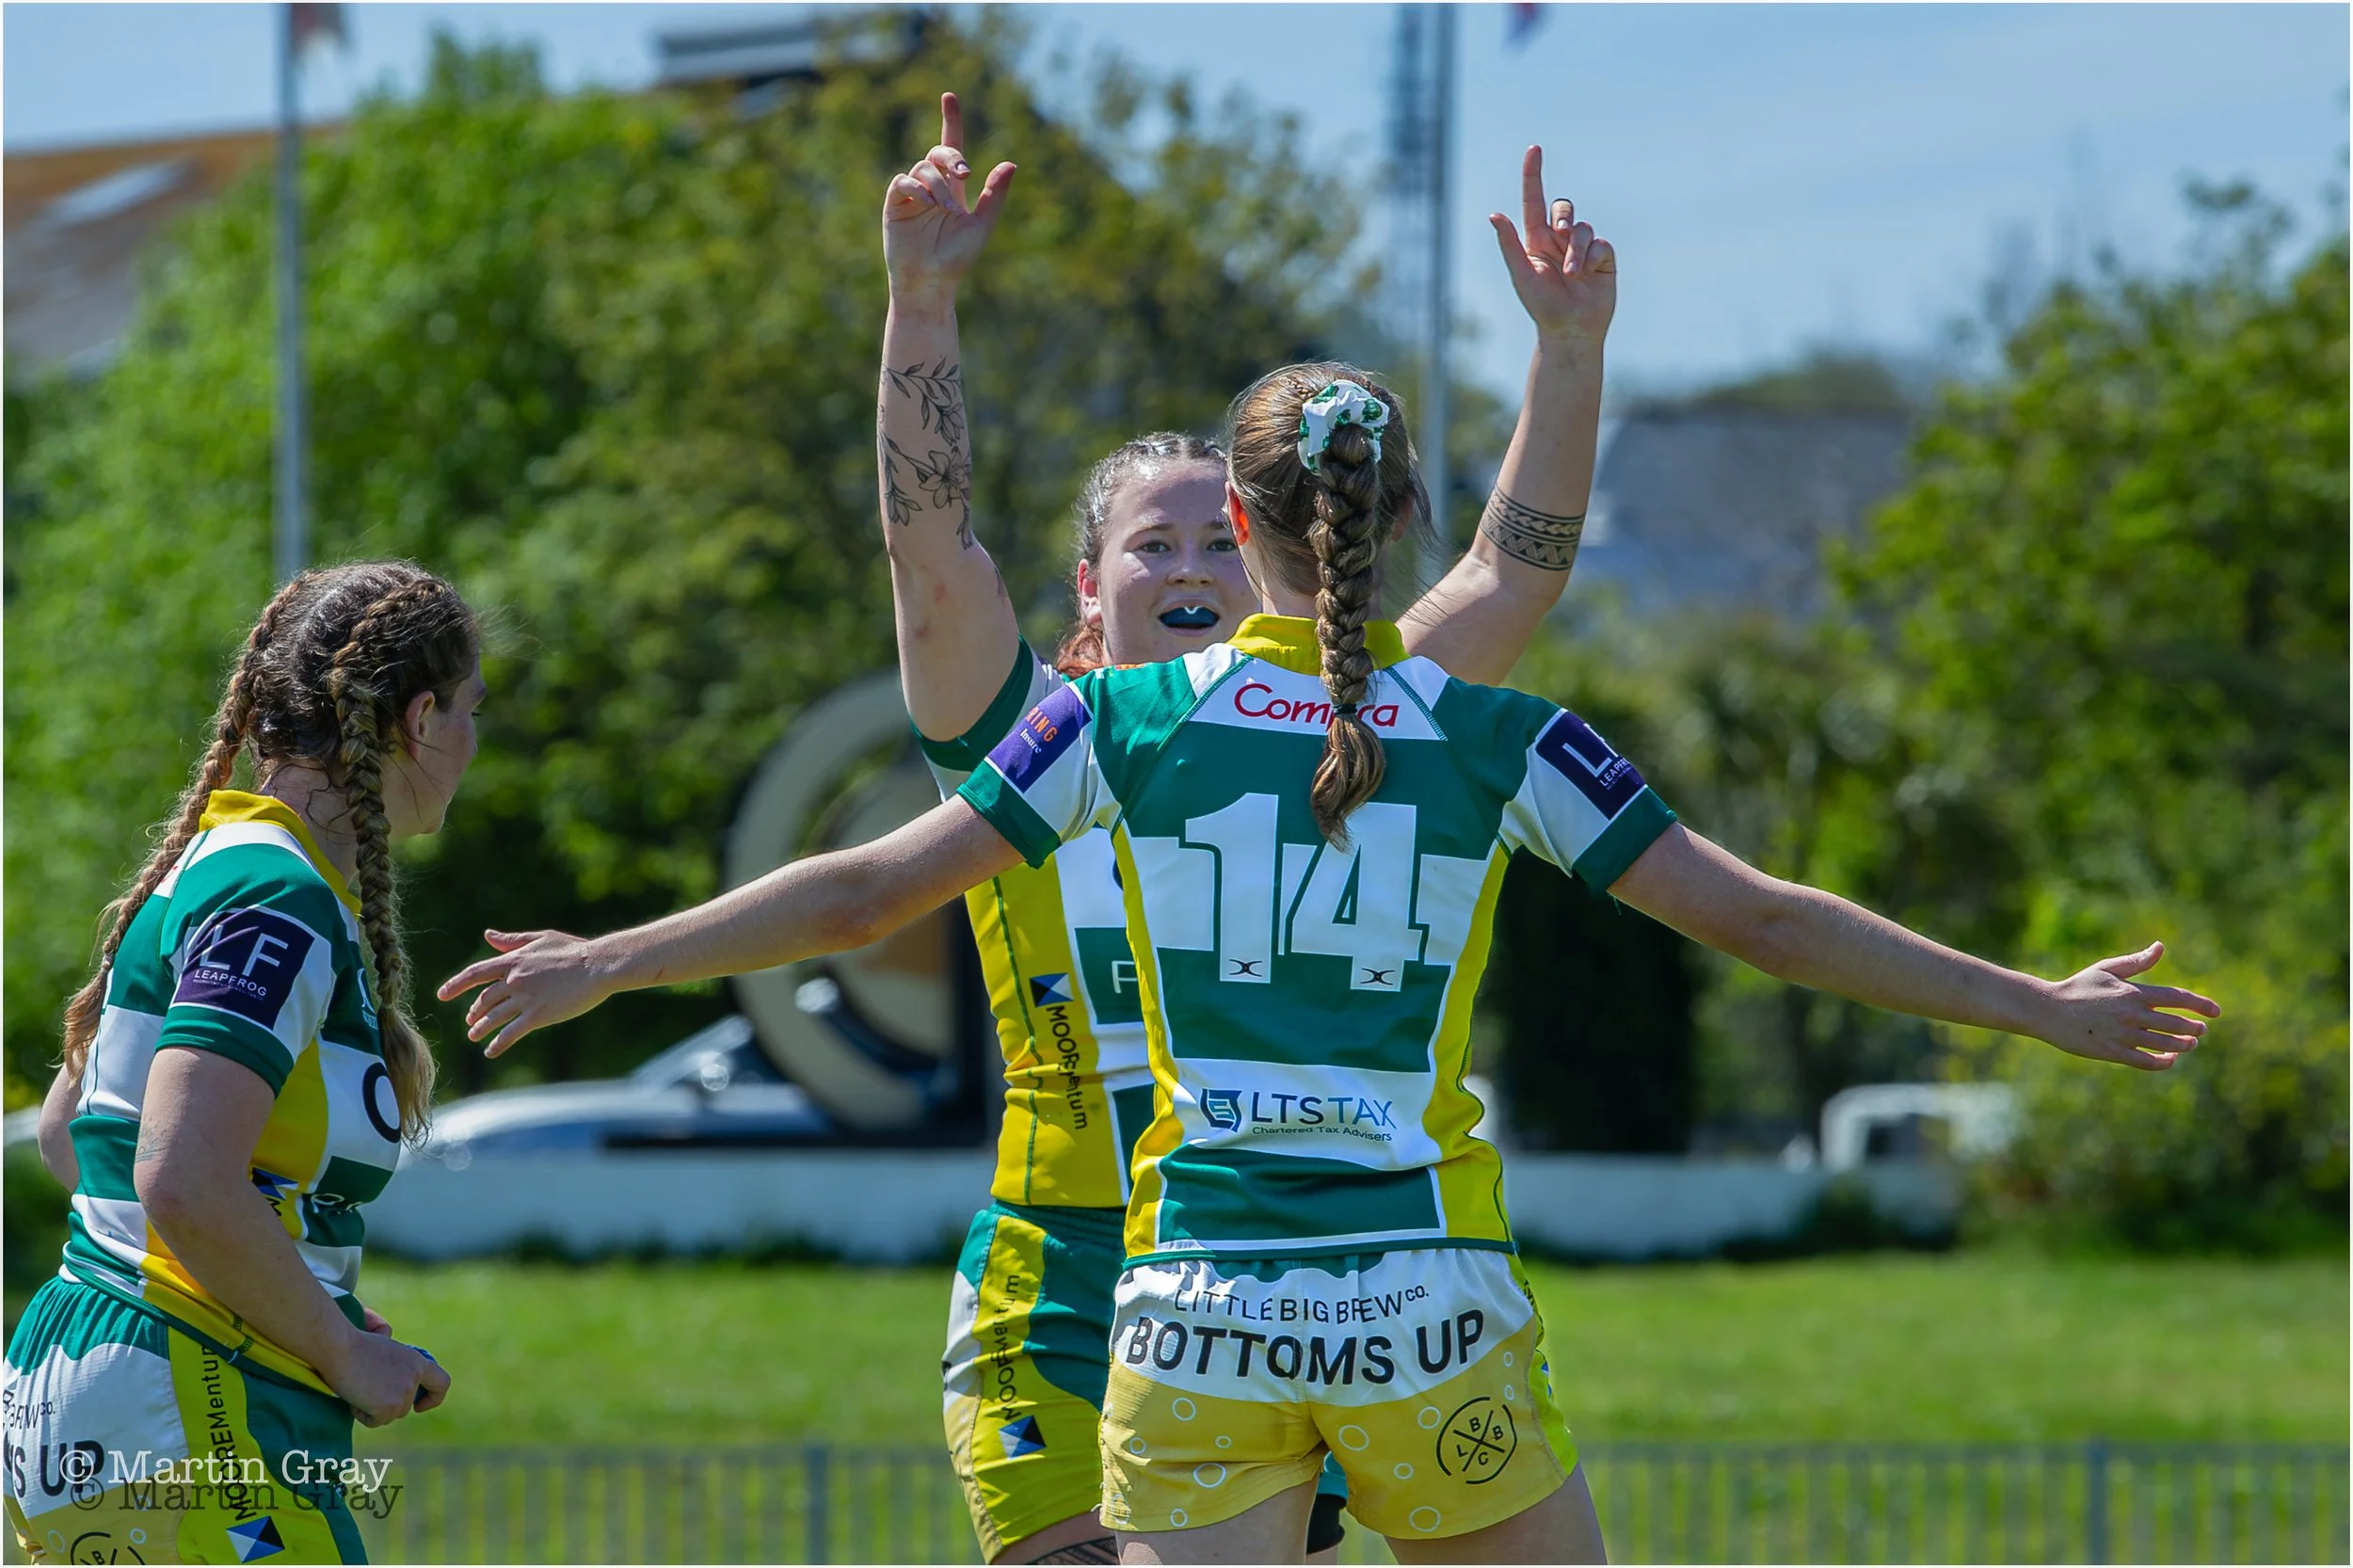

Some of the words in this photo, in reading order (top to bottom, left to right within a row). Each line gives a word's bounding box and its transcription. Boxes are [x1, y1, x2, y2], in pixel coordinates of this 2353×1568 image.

[1234, 683, 1400, 732] Comra
[1186, 792, 1423, 992] 14
[200, 924, 289, 977] LF
[194, 969, 267, 997] LEAPFROG
[1251, 1091, 1324, 1125] LTS
[1327, 1096, 1398, 1129] TAX
[1252, 1126, 1314, 1135] Chartered
[1317, 1126, 1339, 1134] Tax
[1342, 1127, 1393, 1142] Advisers
[1175, 1289, 1273, 1321] LITTLE
[1280, 1298, 1330, 1323] BIG
[1405, 1285, 1430, 1303] CO.
[1126, 1316, 1396, 1386] BOTTOMS
[1416, 1308, 1484, 1374] UP
